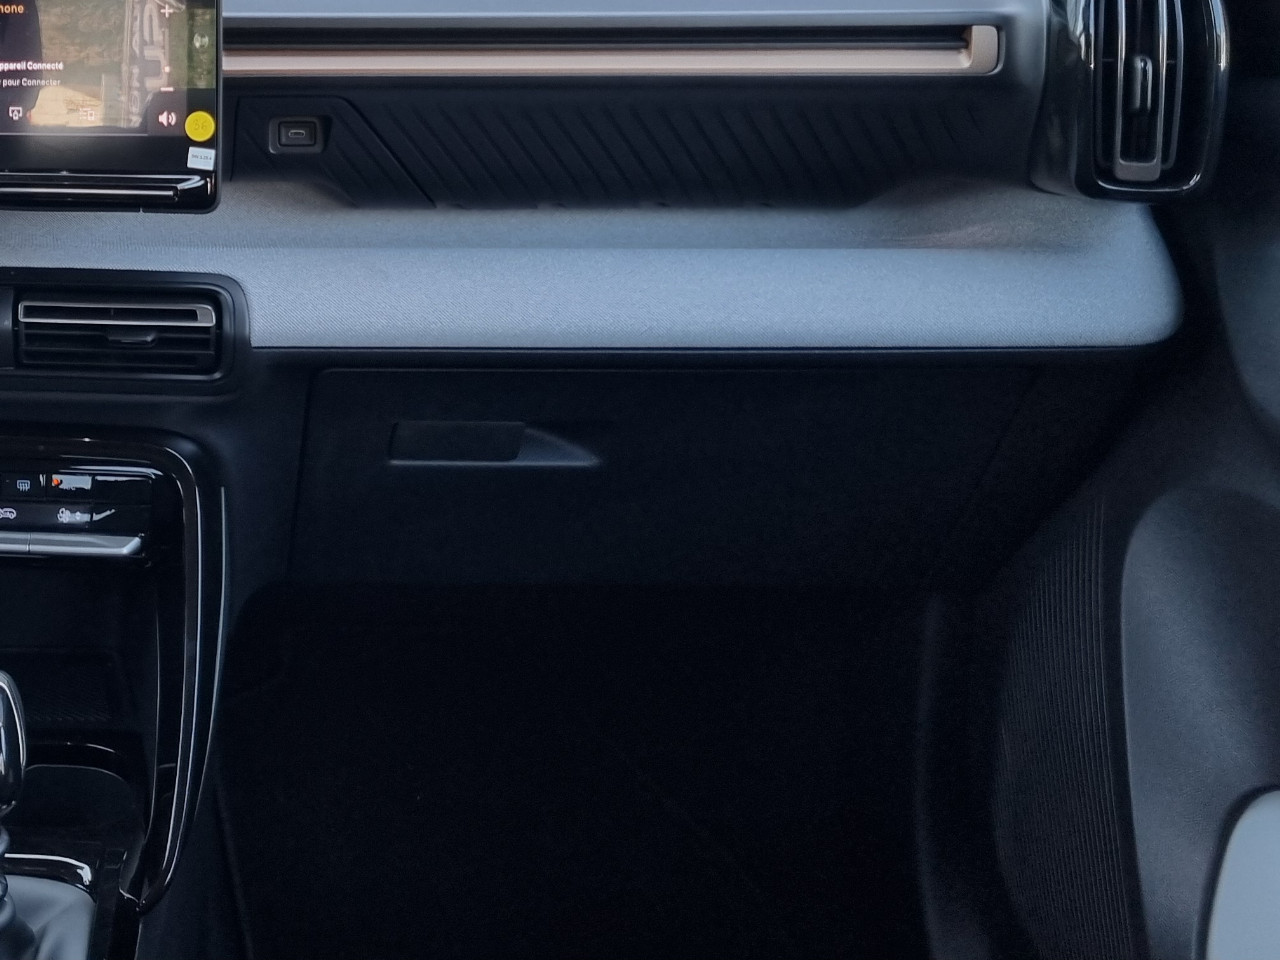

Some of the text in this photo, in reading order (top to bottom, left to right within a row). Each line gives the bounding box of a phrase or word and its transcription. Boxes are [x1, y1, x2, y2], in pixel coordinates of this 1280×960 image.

[27, 60, 64, 71] Connecté
[2, 79, 20, 87] pour
[21, 77, 61, 87] Connecter
